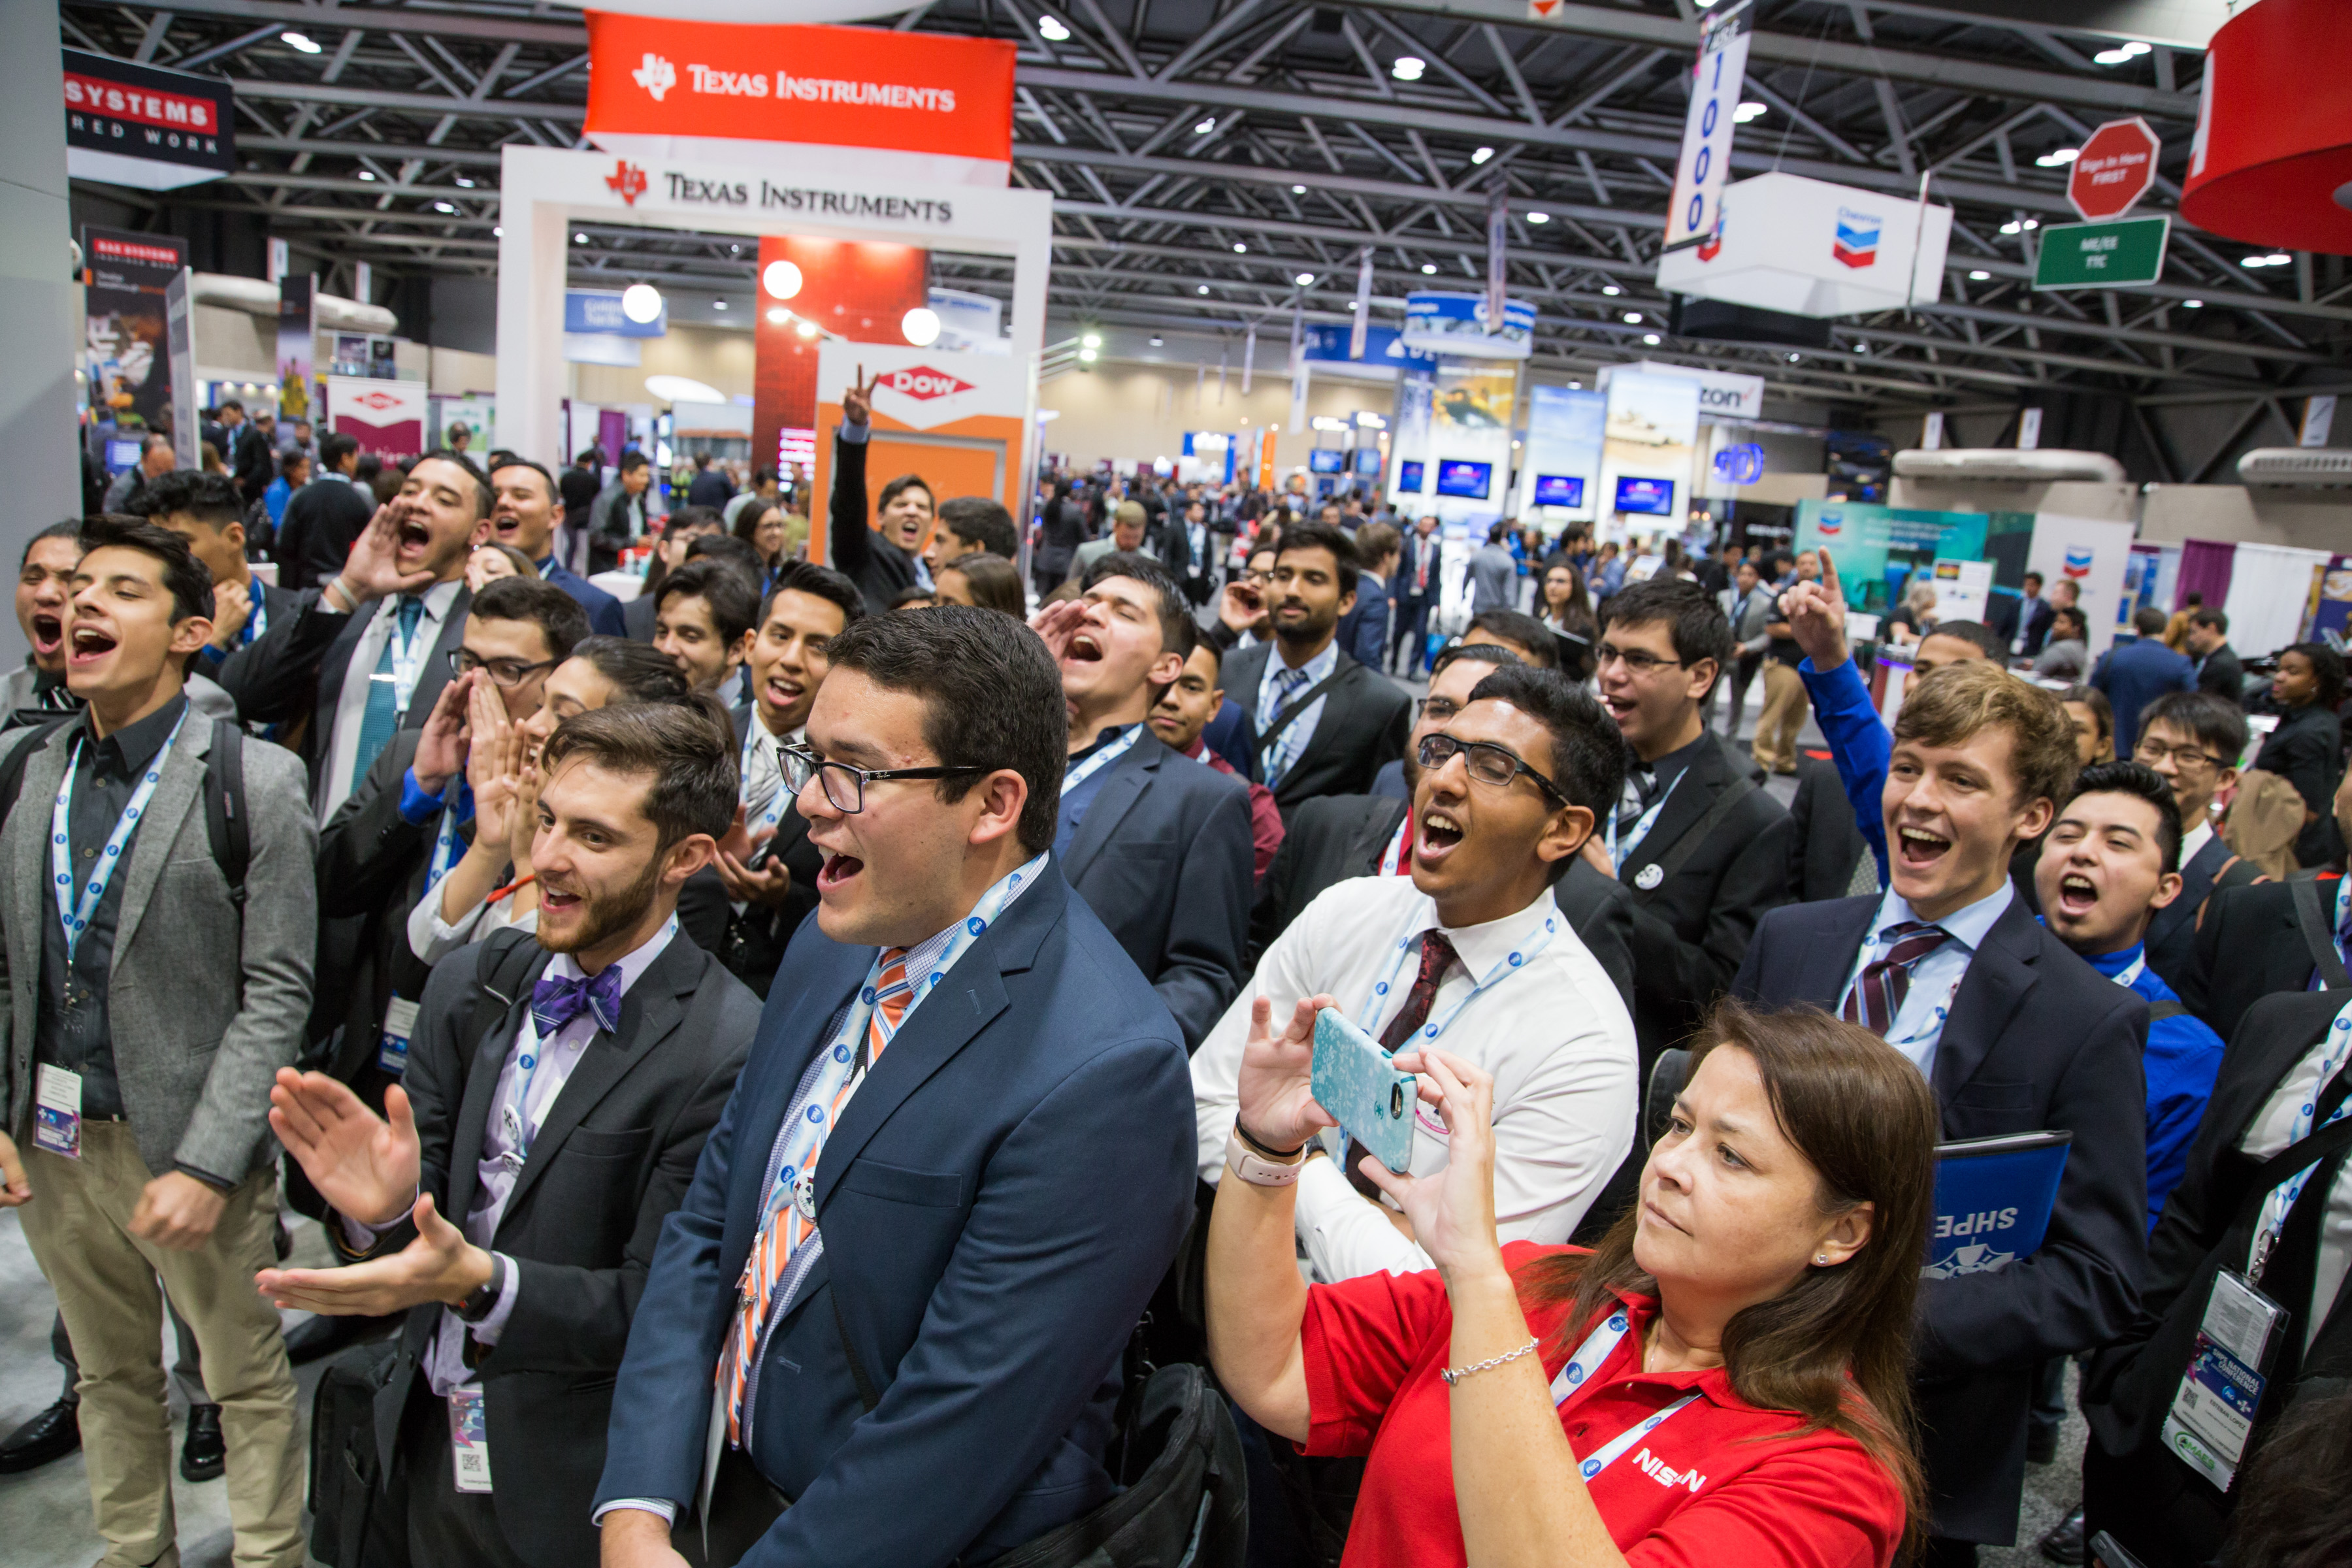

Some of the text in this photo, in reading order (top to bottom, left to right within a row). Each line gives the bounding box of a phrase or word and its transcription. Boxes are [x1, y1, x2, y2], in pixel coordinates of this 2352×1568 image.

[687, 63, 955, 112] TEXAS INSTRUMENTS
[65, 80, 208, 127] SYSTEMS
[144, 127, 219, 155] WORK
[1688, 52, 1723, 232] 1000
[2080, 152, 2147, 174] Sign In Here
[2092, 168, 2127, 186] FIRST
[664, 172, 953, 223] TEXAS INSTRUMENTS
[893, 372, 957, 395] DOW
[971, 918, 983, 934] P&G
[837, 1047, 847, 1062] P&G
[810, 1107, 821, 1122] P&G
[1934, 1207, 2018, 1238] SHPE
[2218, 1360, 2259, 1396] CONFERENCE
[2227, 1360, 2260, 1386] NATIONAL
[2210, 1399, 2230, 1418] ESTEBAN
[2229, 1415, 2246, 1430] LOPEZ
[1586, 1461, 1599, 1475] P&G
